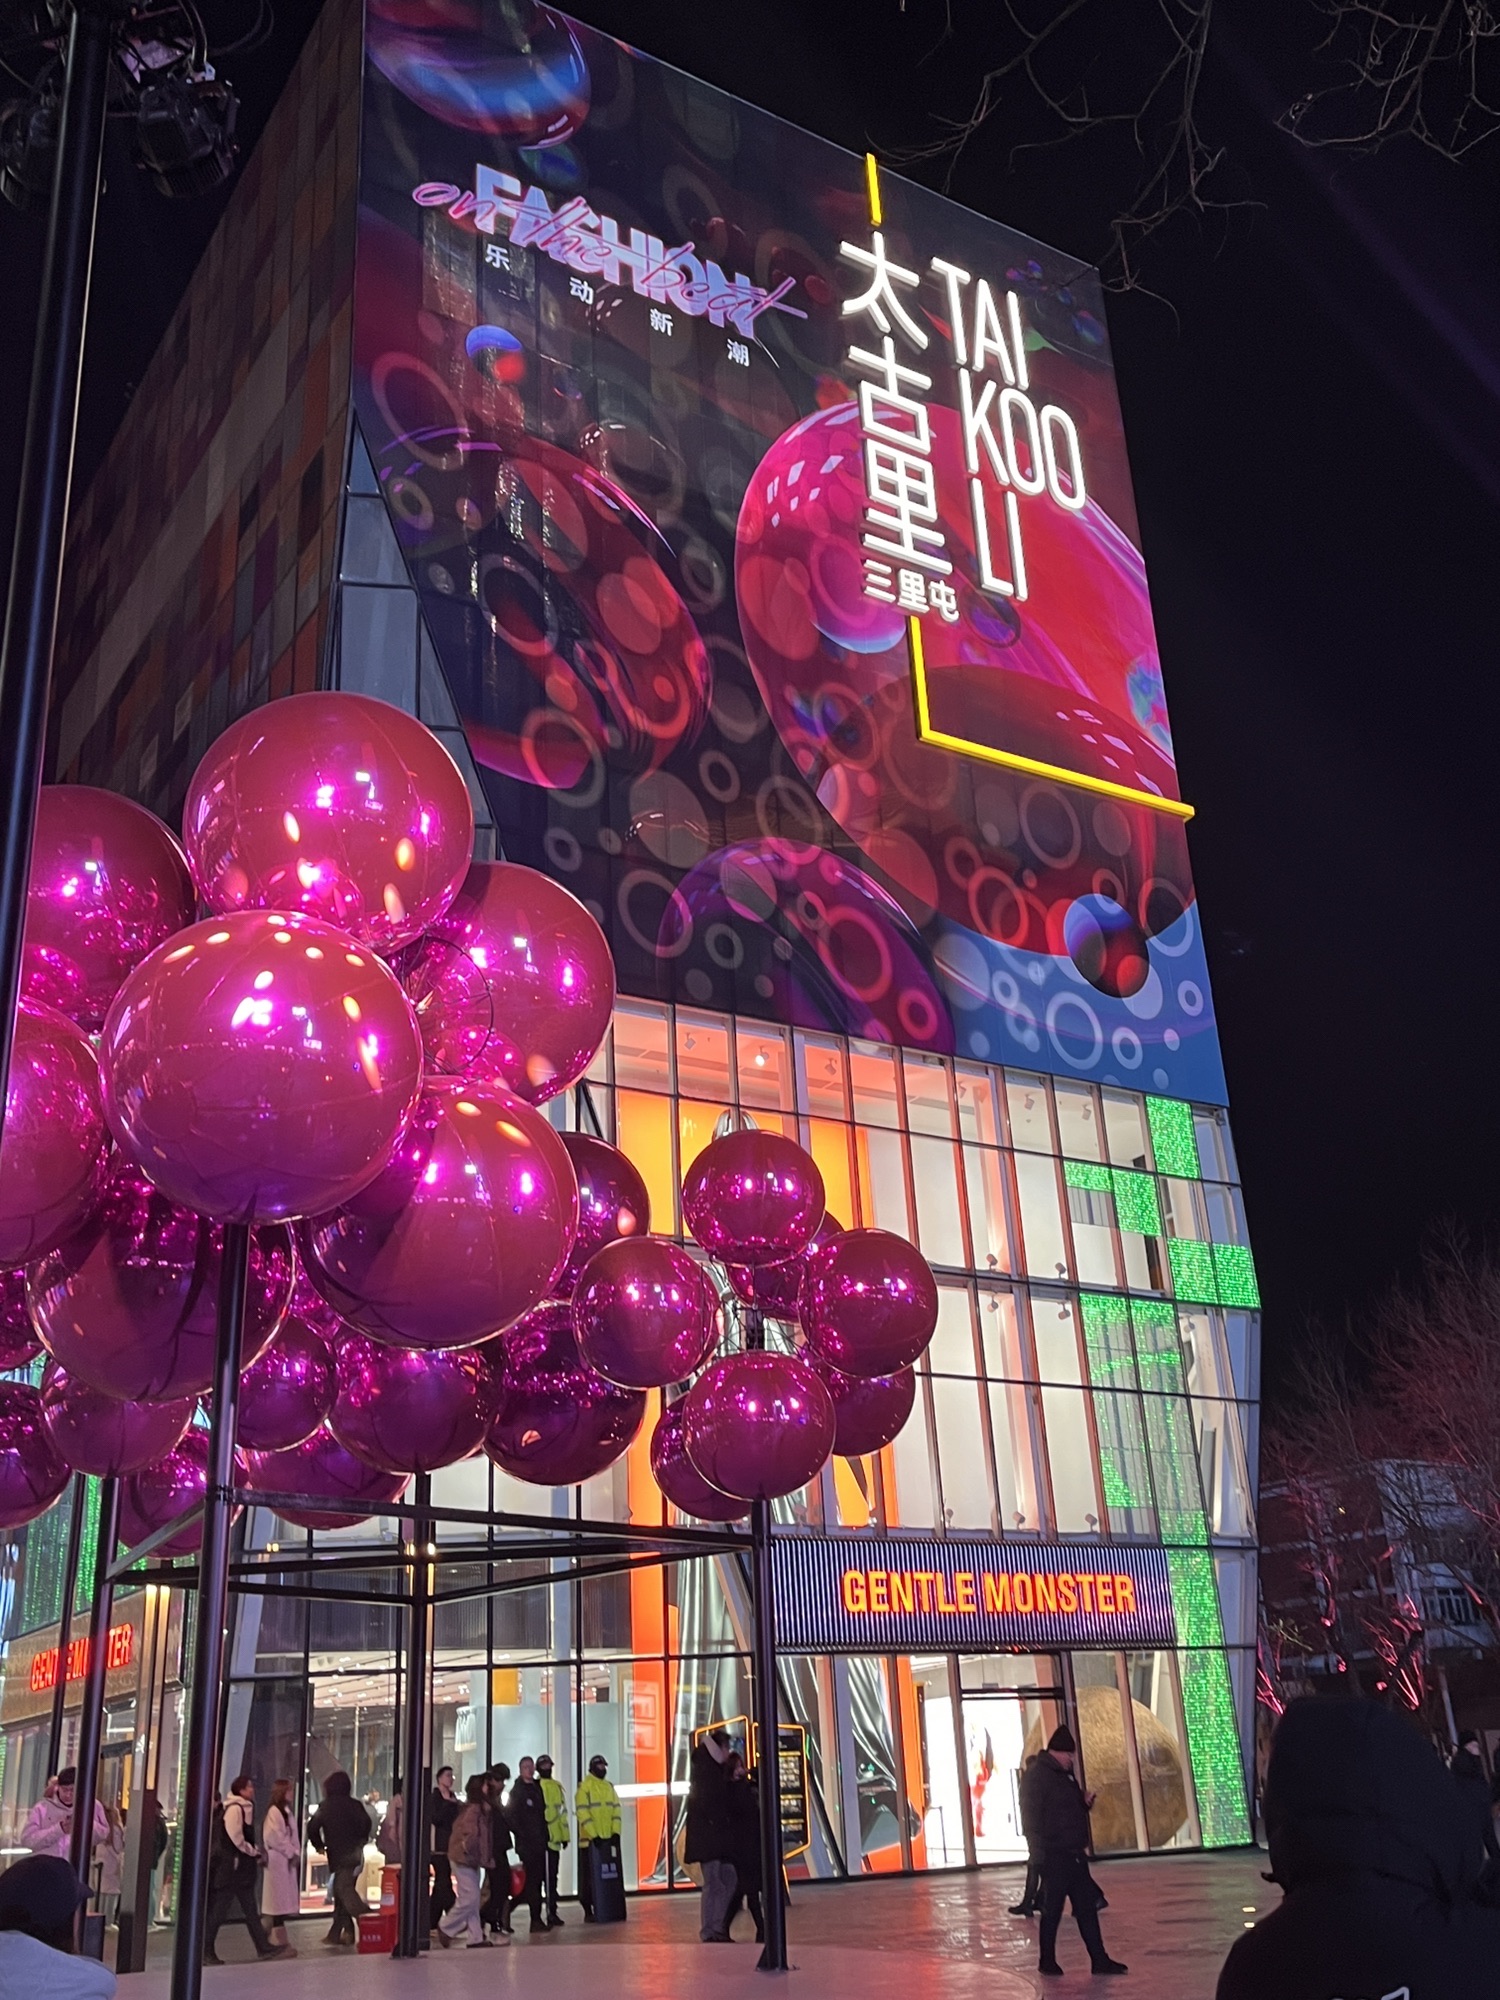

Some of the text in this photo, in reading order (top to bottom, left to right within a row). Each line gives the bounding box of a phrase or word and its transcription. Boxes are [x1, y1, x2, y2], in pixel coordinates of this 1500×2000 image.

[412, 181, 497, 224] on
[485, 244, 750, 367] 乐动新潮
[930, 256, 1030, 390] TAI
[839, 231, 953, 574] 太古里
[960, 367, 1087, 510] KOO
[863, 558, 960, 623] 三里屯
[971, 477, 1029, 602] LI
[842, 1569, 1135, 1614] GENTLE MONSTER
